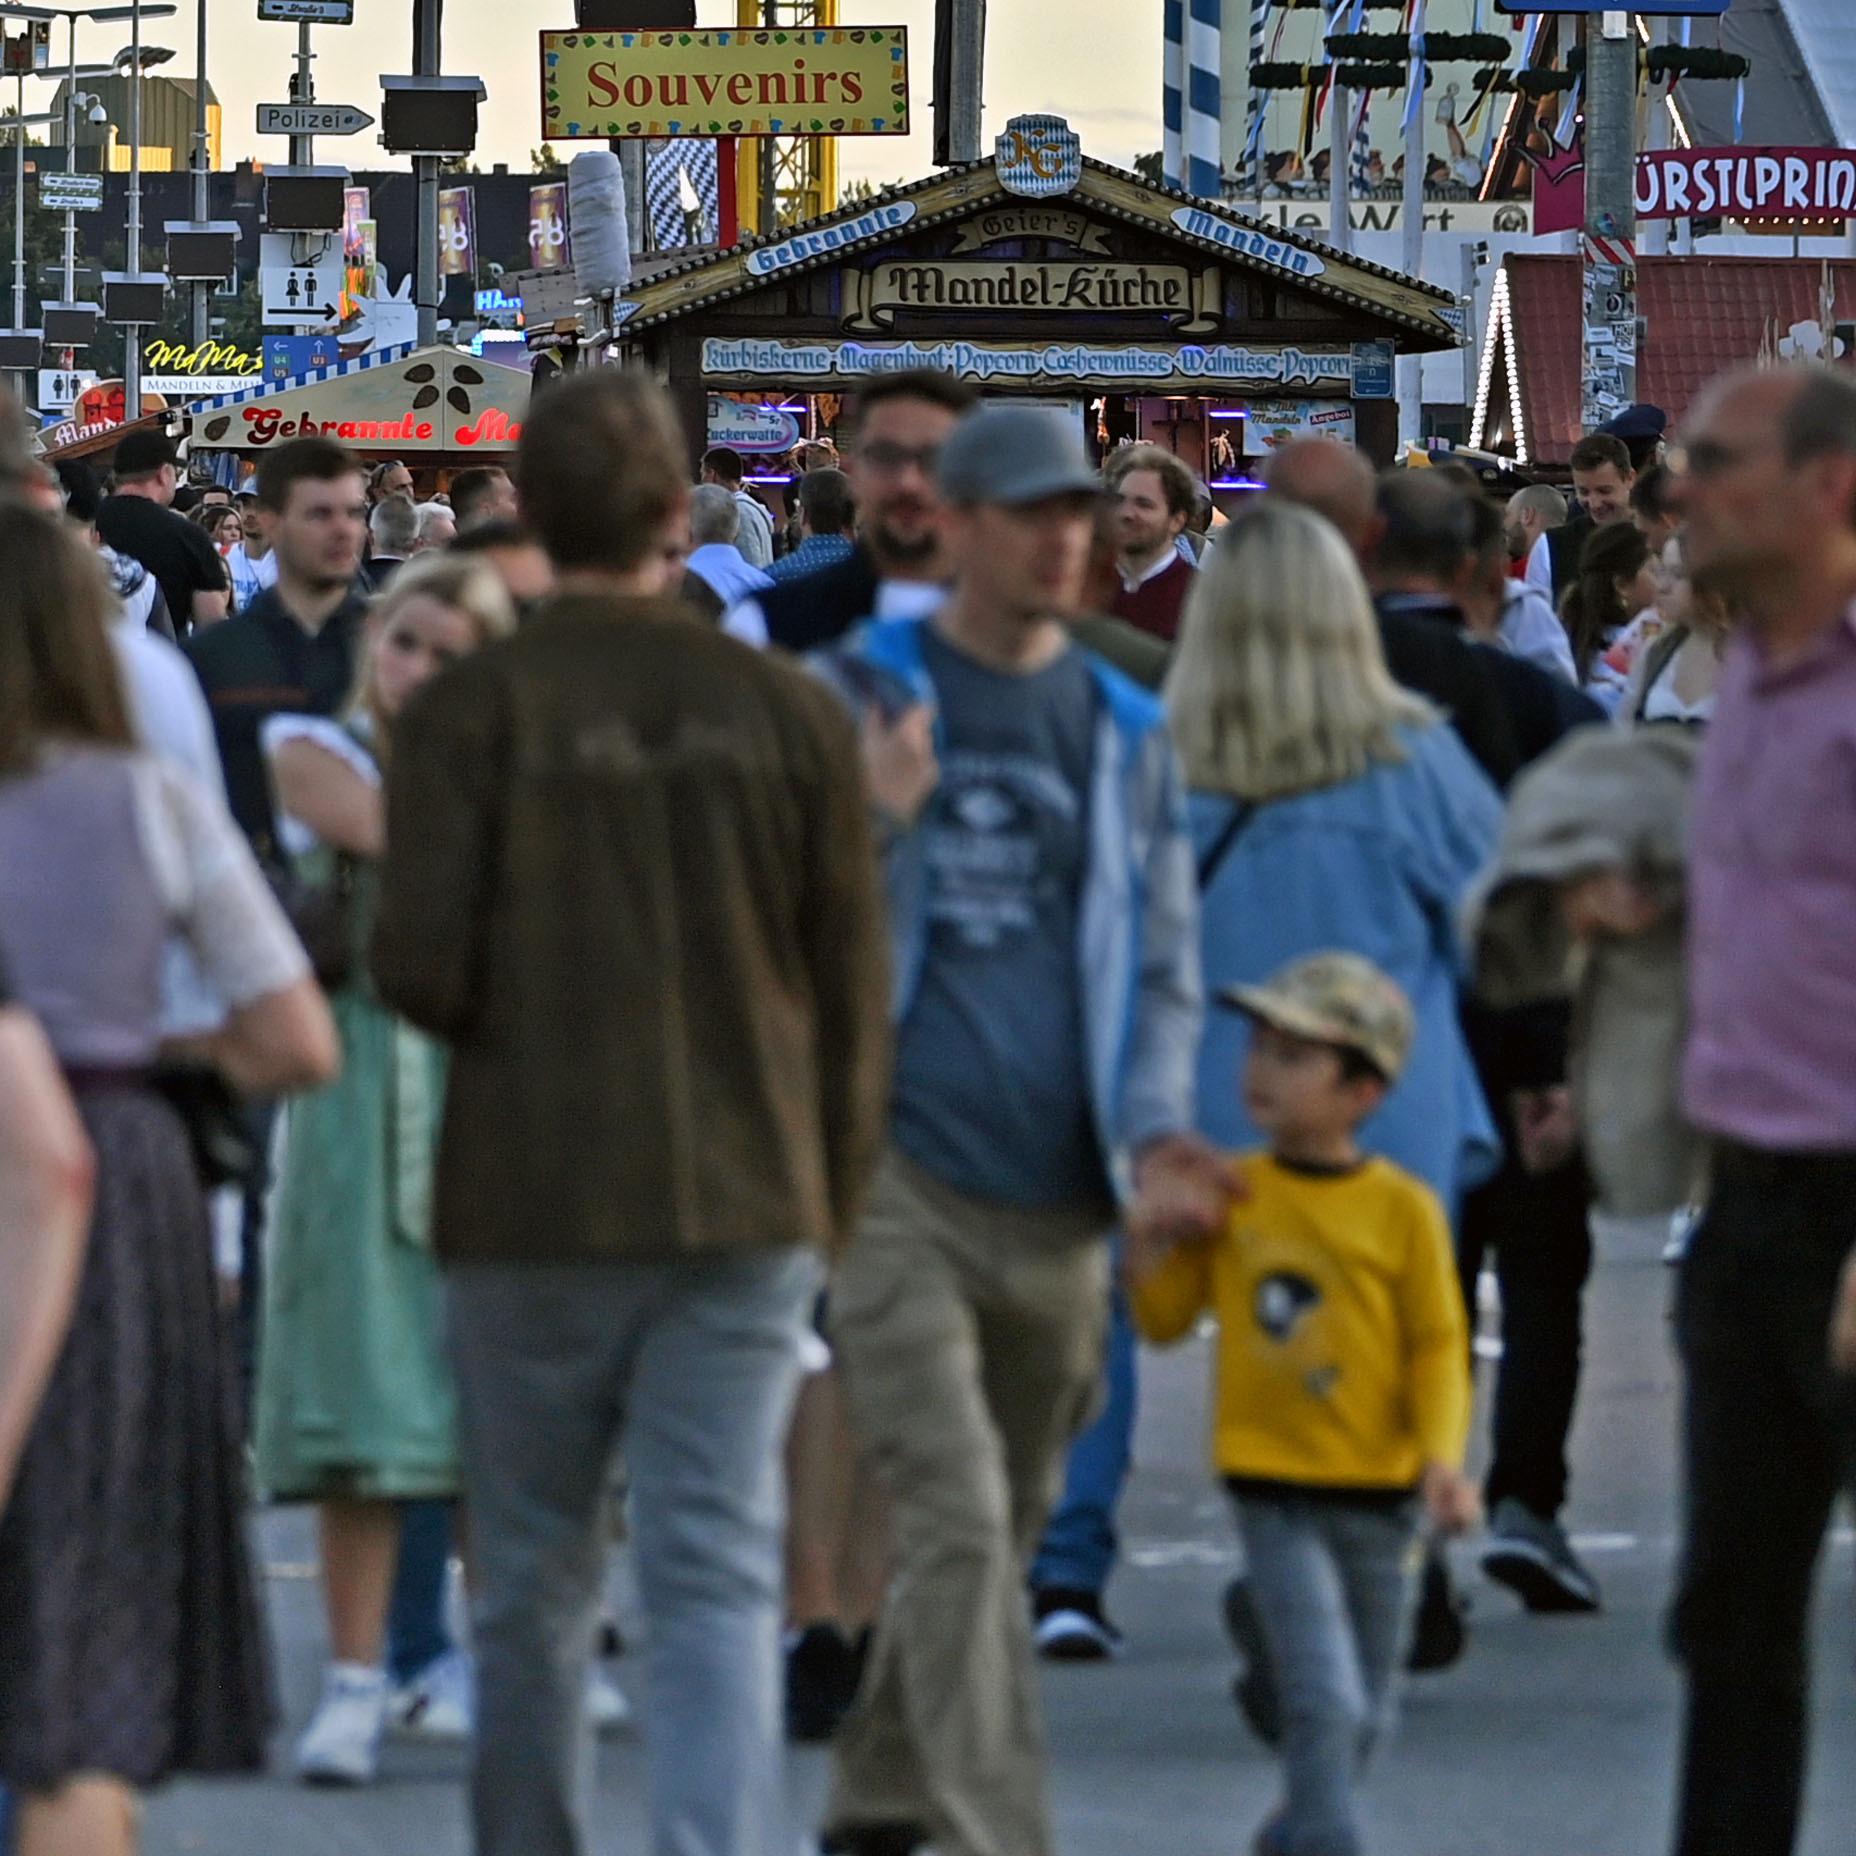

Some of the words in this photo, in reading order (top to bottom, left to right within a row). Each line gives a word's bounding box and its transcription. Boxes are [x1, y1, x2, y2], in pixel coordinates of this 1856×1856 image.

[587, 58, 864, 109] Souvenirs
[268, 110, 341, 129] Polizei
[755, 204, 903, 272] Gebrannte
[981, 206, 1079, 237] Geier's
[1185, 208, 1310, 275] Mandeln
[887, 264, 1183, 309] Mandel-Küche
[147, 379, 214, 392] MANDELN
[215, 380, 228, 391] &
[242, 406, 434, 445] Gebrannte
